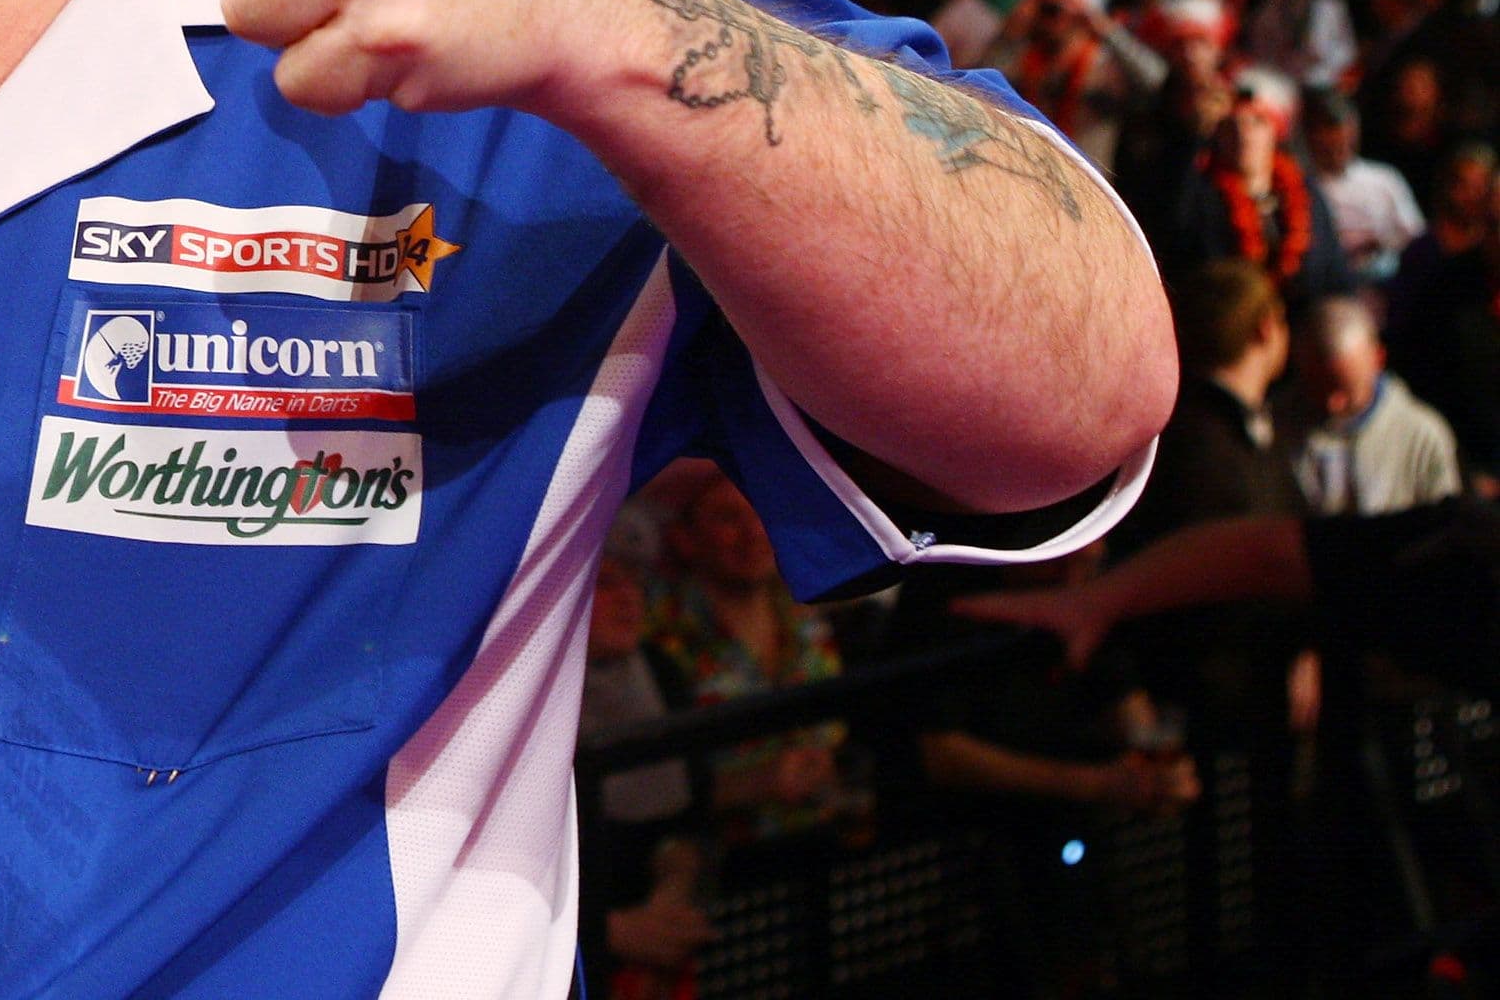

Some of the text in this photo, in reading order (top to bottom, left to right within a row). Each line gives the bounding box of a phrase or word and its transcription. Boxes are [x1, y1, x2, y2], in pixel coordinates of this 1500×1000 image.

[81, 227, 166, 258] SKY
[179, 232, 339, 273] SPORTS
[349, 248, 397, 277] HD
[155, 391, 360, 412] The Big Name in Darts
[42, 431, 414, 538] Worthington's
